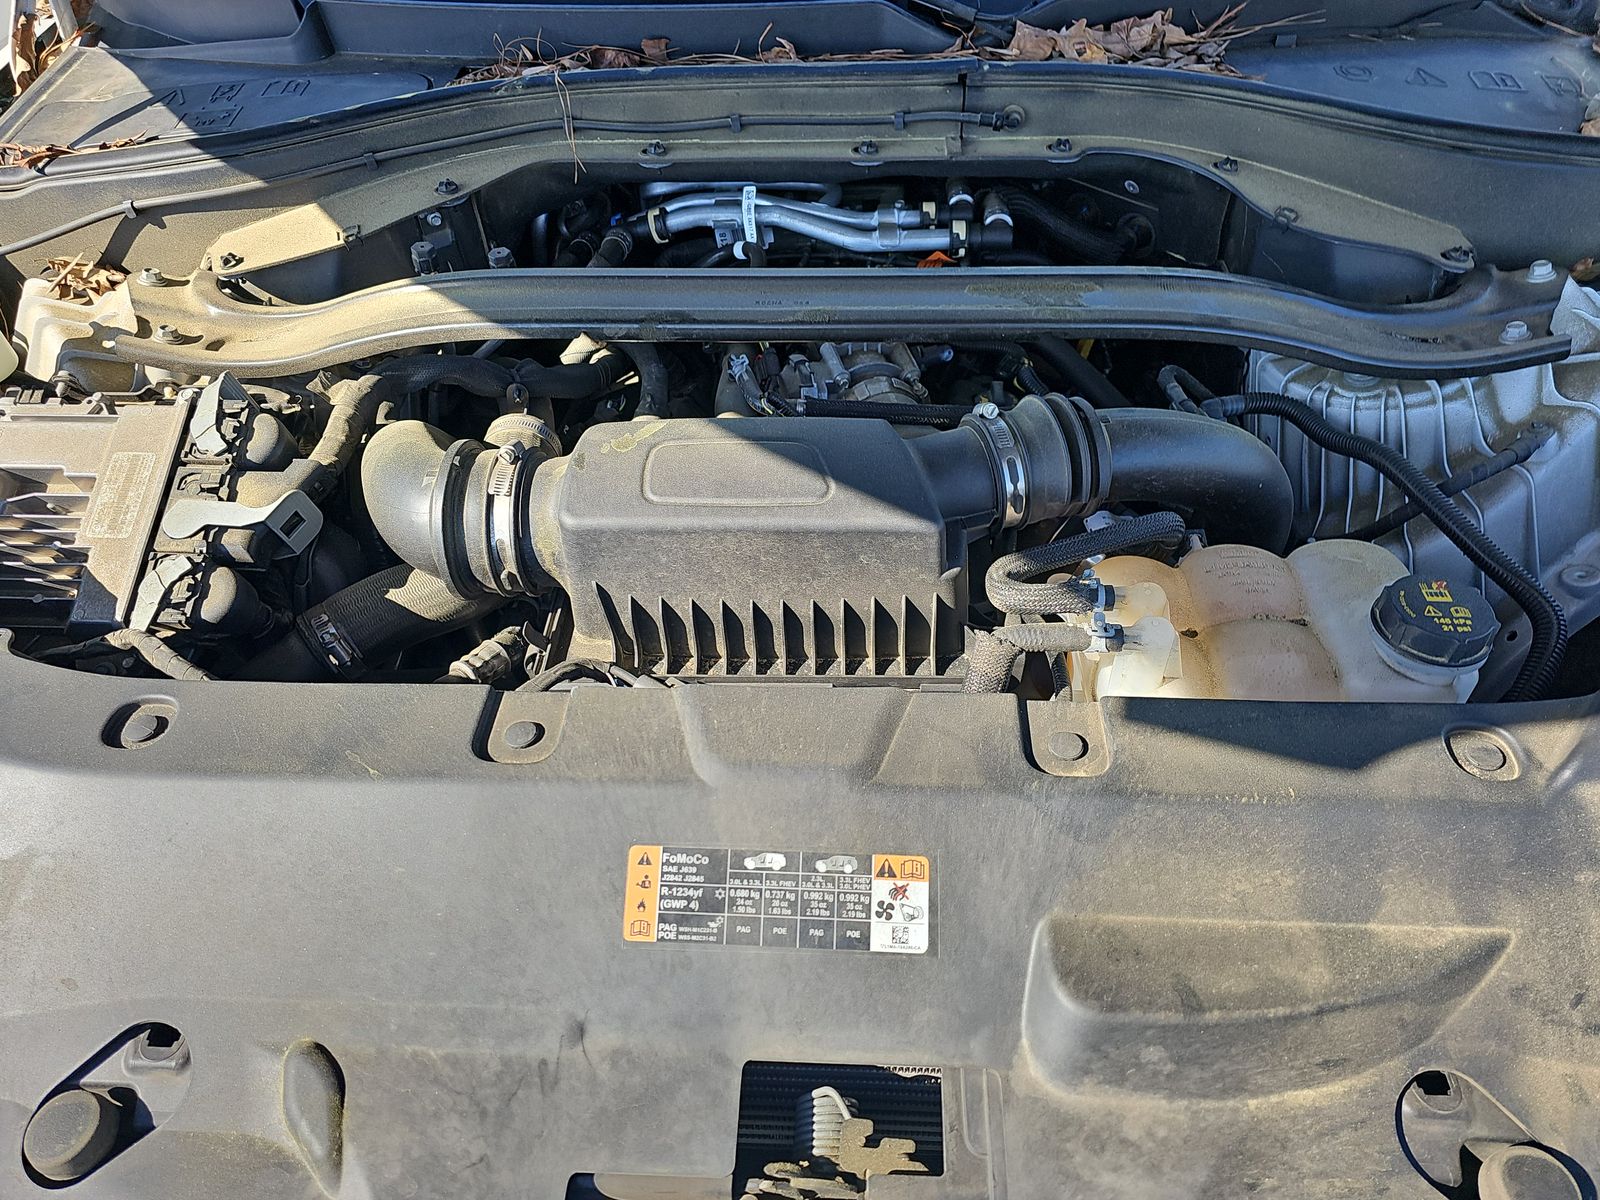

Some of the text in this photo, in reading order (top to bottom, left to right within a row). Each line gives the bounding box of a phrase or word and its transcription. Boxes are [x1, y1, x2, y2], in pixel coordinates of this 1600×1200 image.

[1456, 625, 1472, 633] psi
[662, 852, 710, 865] FoMoCo
[683, 875, 704, 883] J2845
[660, 887, 703, 898] R-1234yf
[729, 888, 760, 900] 0.680 kg
[765, 890, 796, 901] 0.737 kg
[803, 892, 834, 902] 0.992 kg
[840, 893, 870, 904] 0.992 kg
[660, 899, 700, 911] (GWP 4)
[658, 923, 678, 932] PAG
[658, 931, 677, 940] POE
[846, 930, 861, 938] POE
